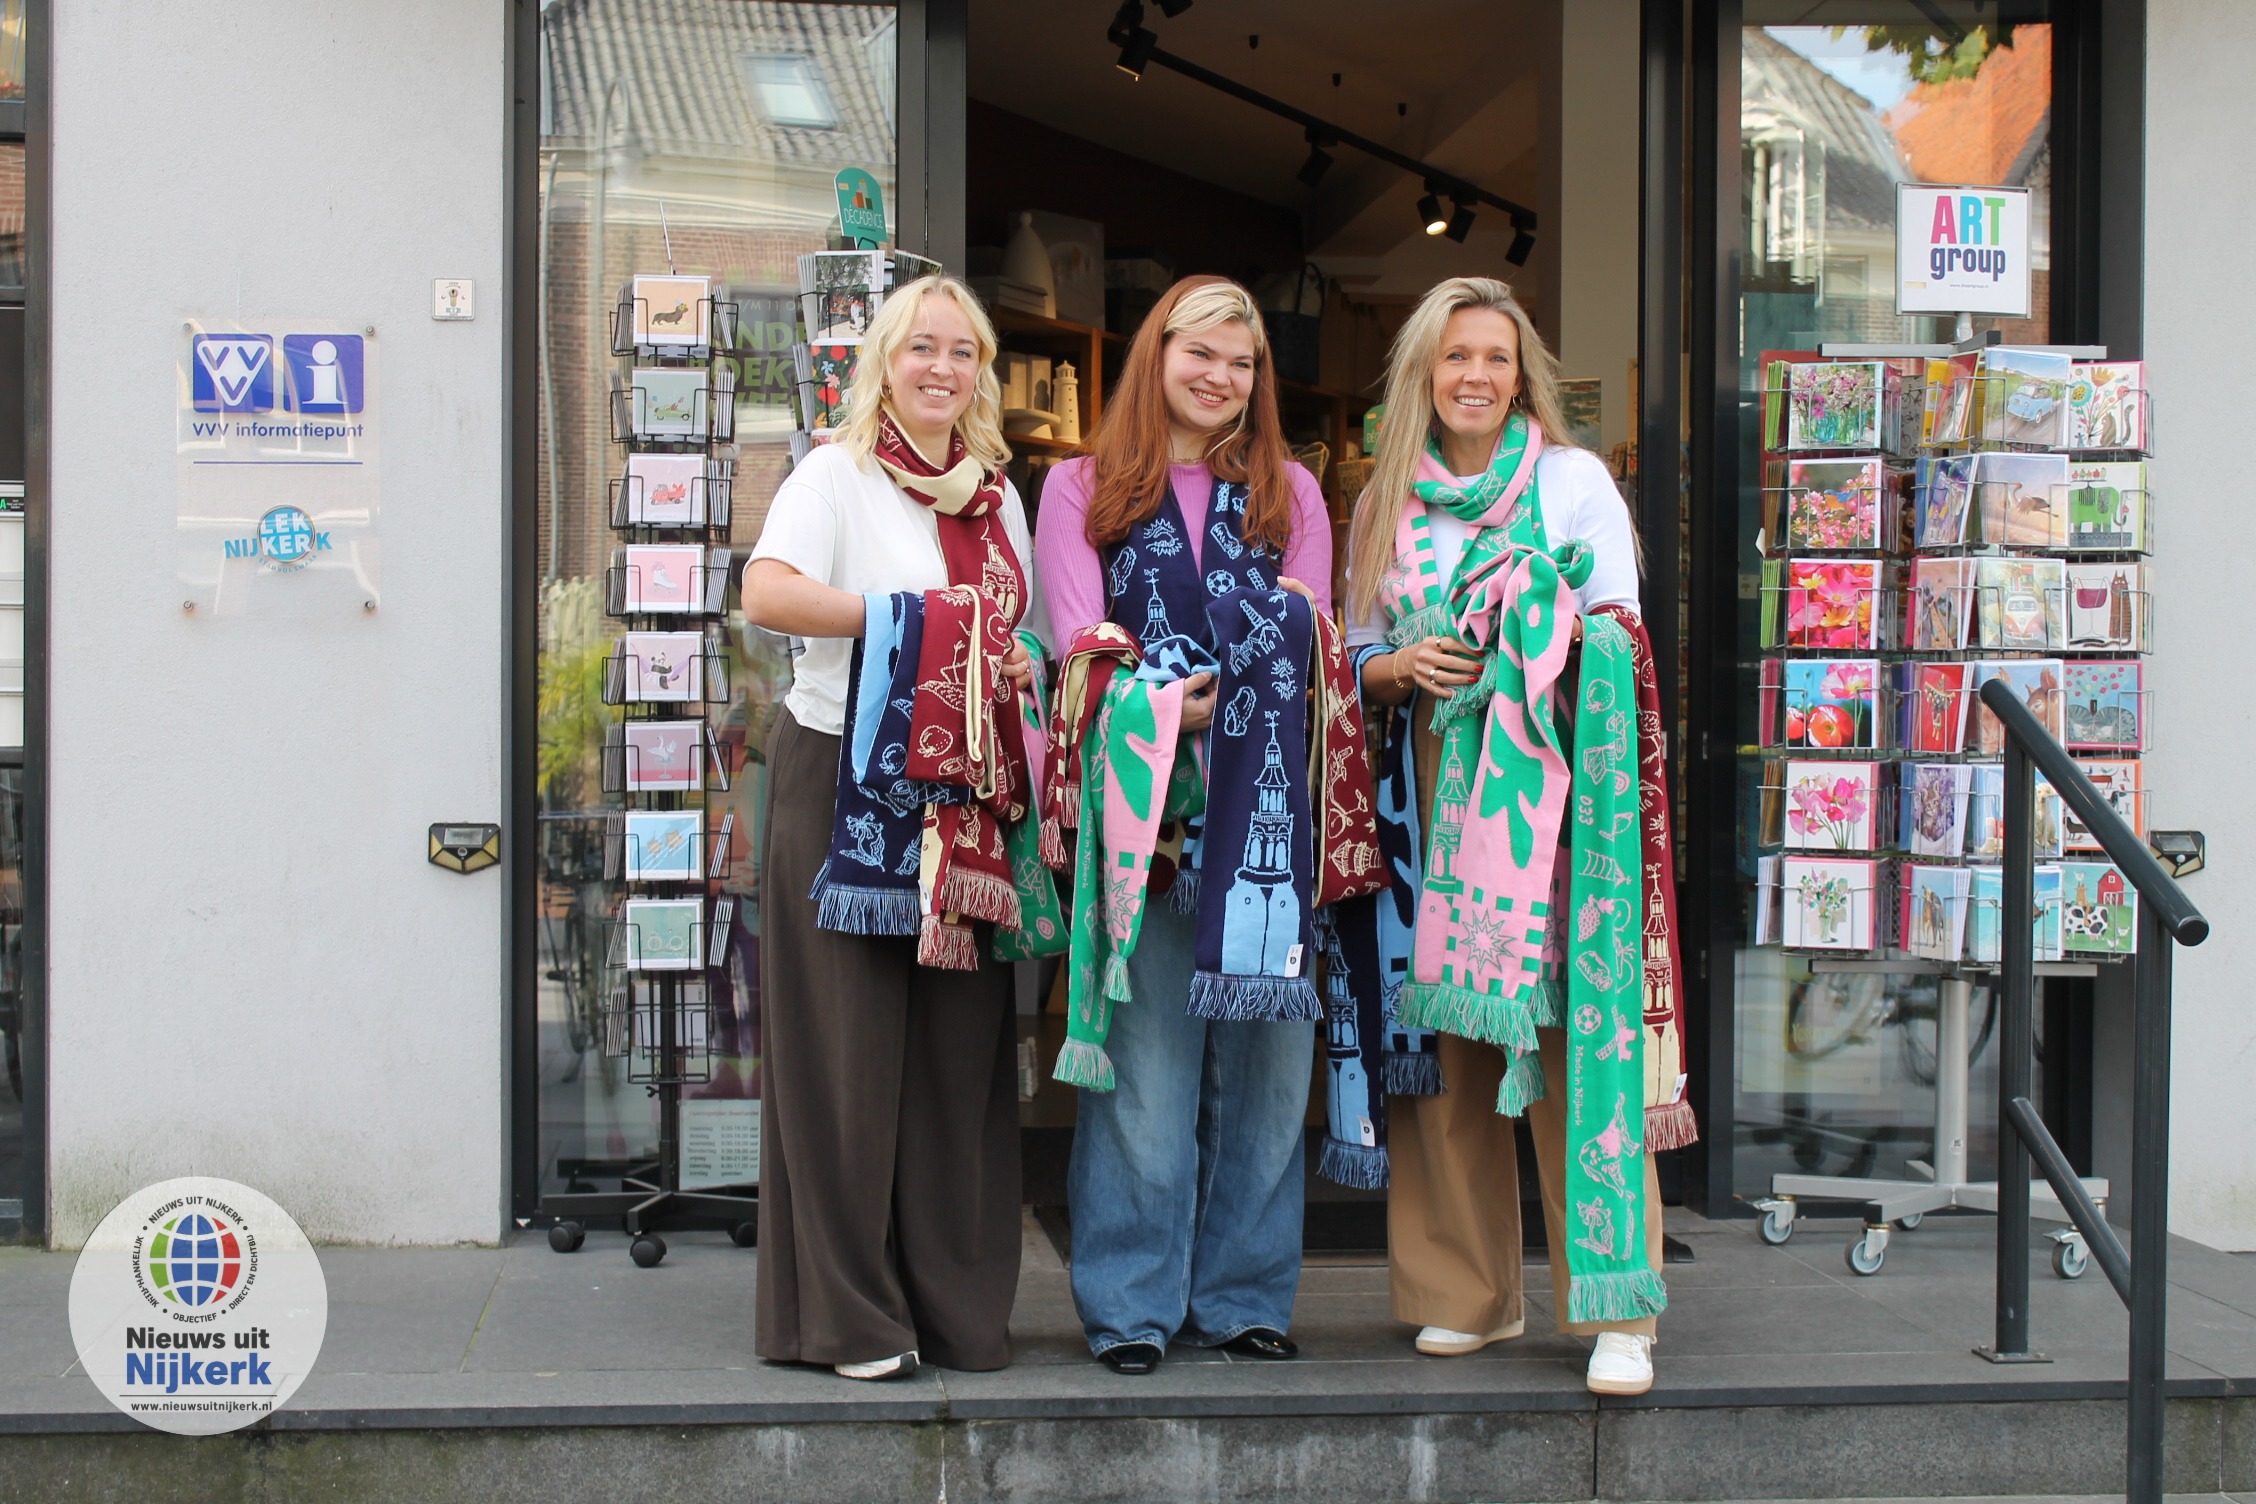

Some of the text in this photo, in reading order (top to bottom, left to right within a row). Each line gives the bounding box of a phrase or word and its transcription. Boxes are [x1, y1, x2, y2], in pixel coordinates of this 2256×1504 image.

[843, 204, 884, 229] DÉCADENCE
[1930, 195, 2006, 246] ART
[1929, 247, 2006, 281] group
[193, 422, 364, 440] VVV informatiepunt
[260, 512, 309, 535] LEK
[1085, 807, 1094, 837] Made
[1578, 795, 1595, 825] 033
[1081, 849, 1092, 889] Nijkerk
[1573, 1045, 1584, 1126] Made in Nijkerk
